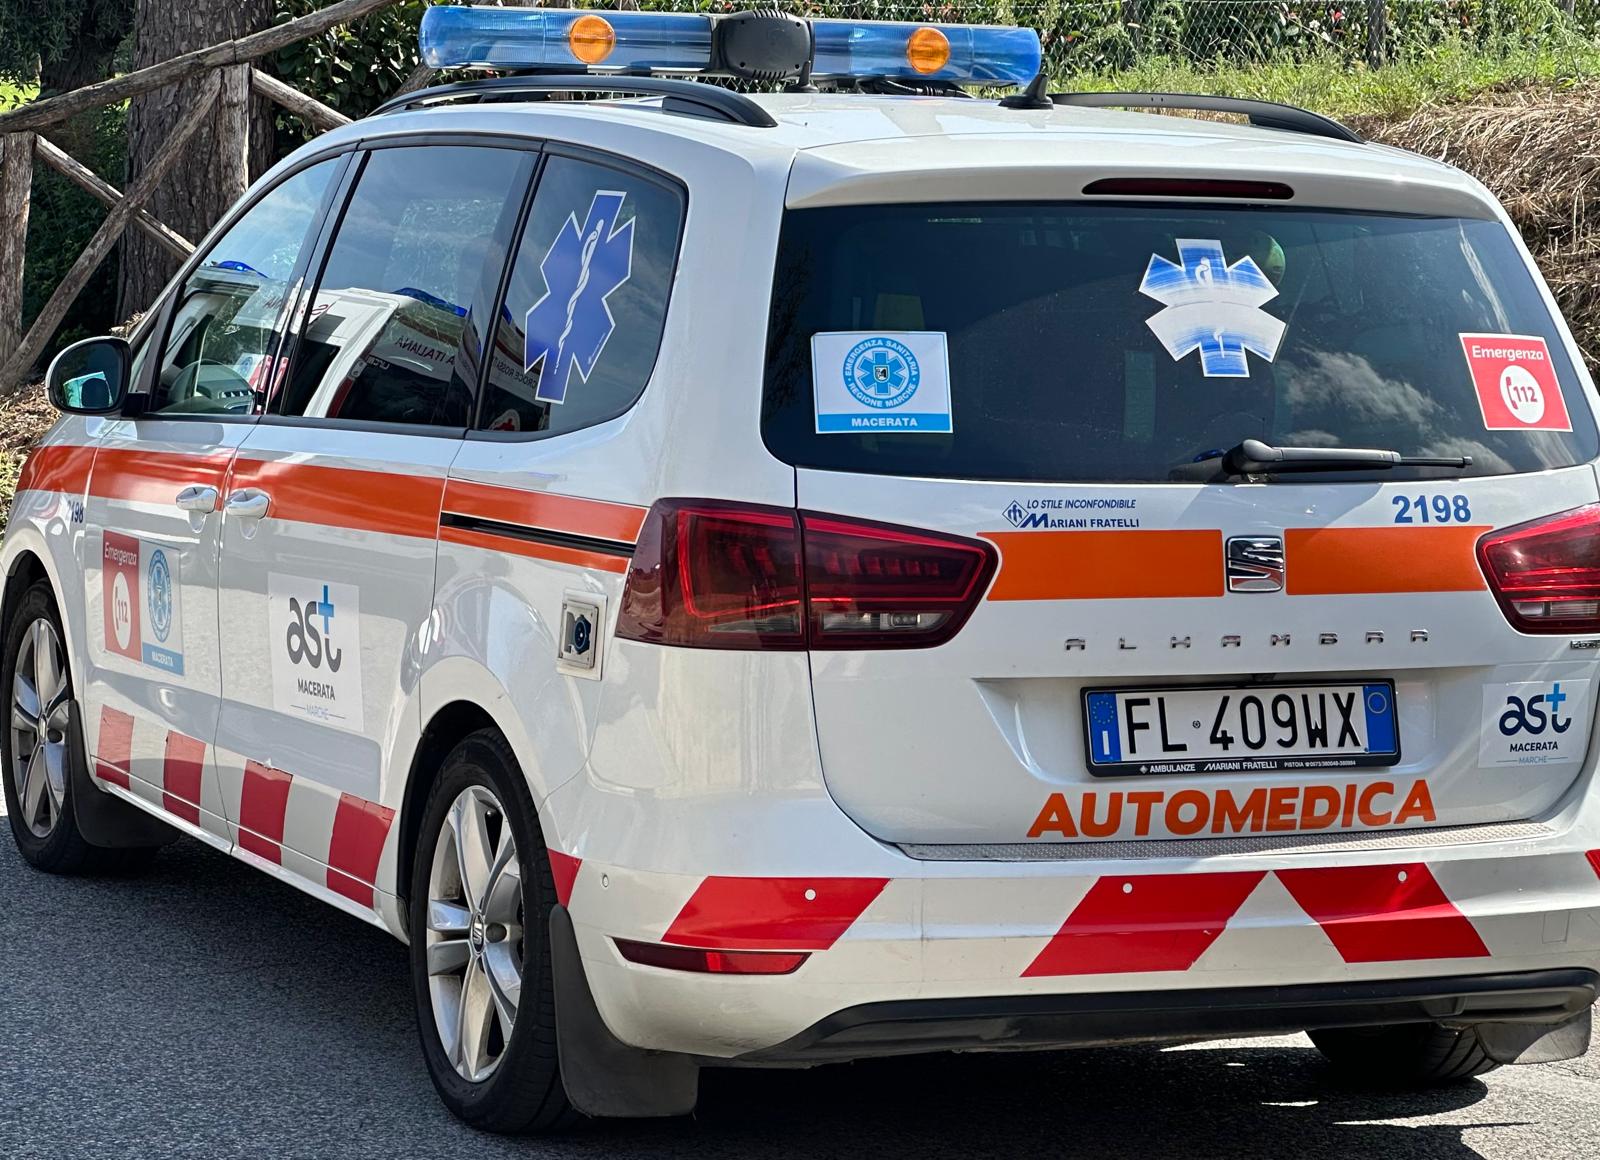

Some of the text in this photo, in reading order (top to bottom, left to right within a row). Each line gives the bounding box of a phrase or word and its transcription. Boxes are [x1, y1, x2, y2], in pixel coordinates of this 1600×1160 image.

[844, 339, 919, 377] EMERGENZA SANITARIA
[1471, 345, 1545, 362] Emergenza
[849, 383, 917, 408] REGIONE MARCHE
[1513, 386, 1538, 403] 112
[851, 417, 919, 427] MACERATA
[1027, 499, 1137, 509] LO STILE INCONFONDIBILE
[1391, 494, 1472, 524] 2198
[1019, 513, 1140, 529] MARIANI FRATELLI
[104, 541, 137, 567] Emergenza
[117, 599, 129, 624] 112
[1065, 628, 1430, 651] ALHAMBRA
[297, 678, 336, 701] MACERATA
[1124, 695, 1188, 754] FL
[1209, 691, 1362, 751] 409WX
[1509, 741, 1559, 753] MACERATA
[1149, 763, 1196, 773] AMBULANZE
[1203, 761, 1241, 771] MARIANI
[1242, 760, 1278, 770] FRATELLI
[1518, 755, 1548, 765] MARCHE
[1026, 779, 1437, 838] AUTOMEDICA
